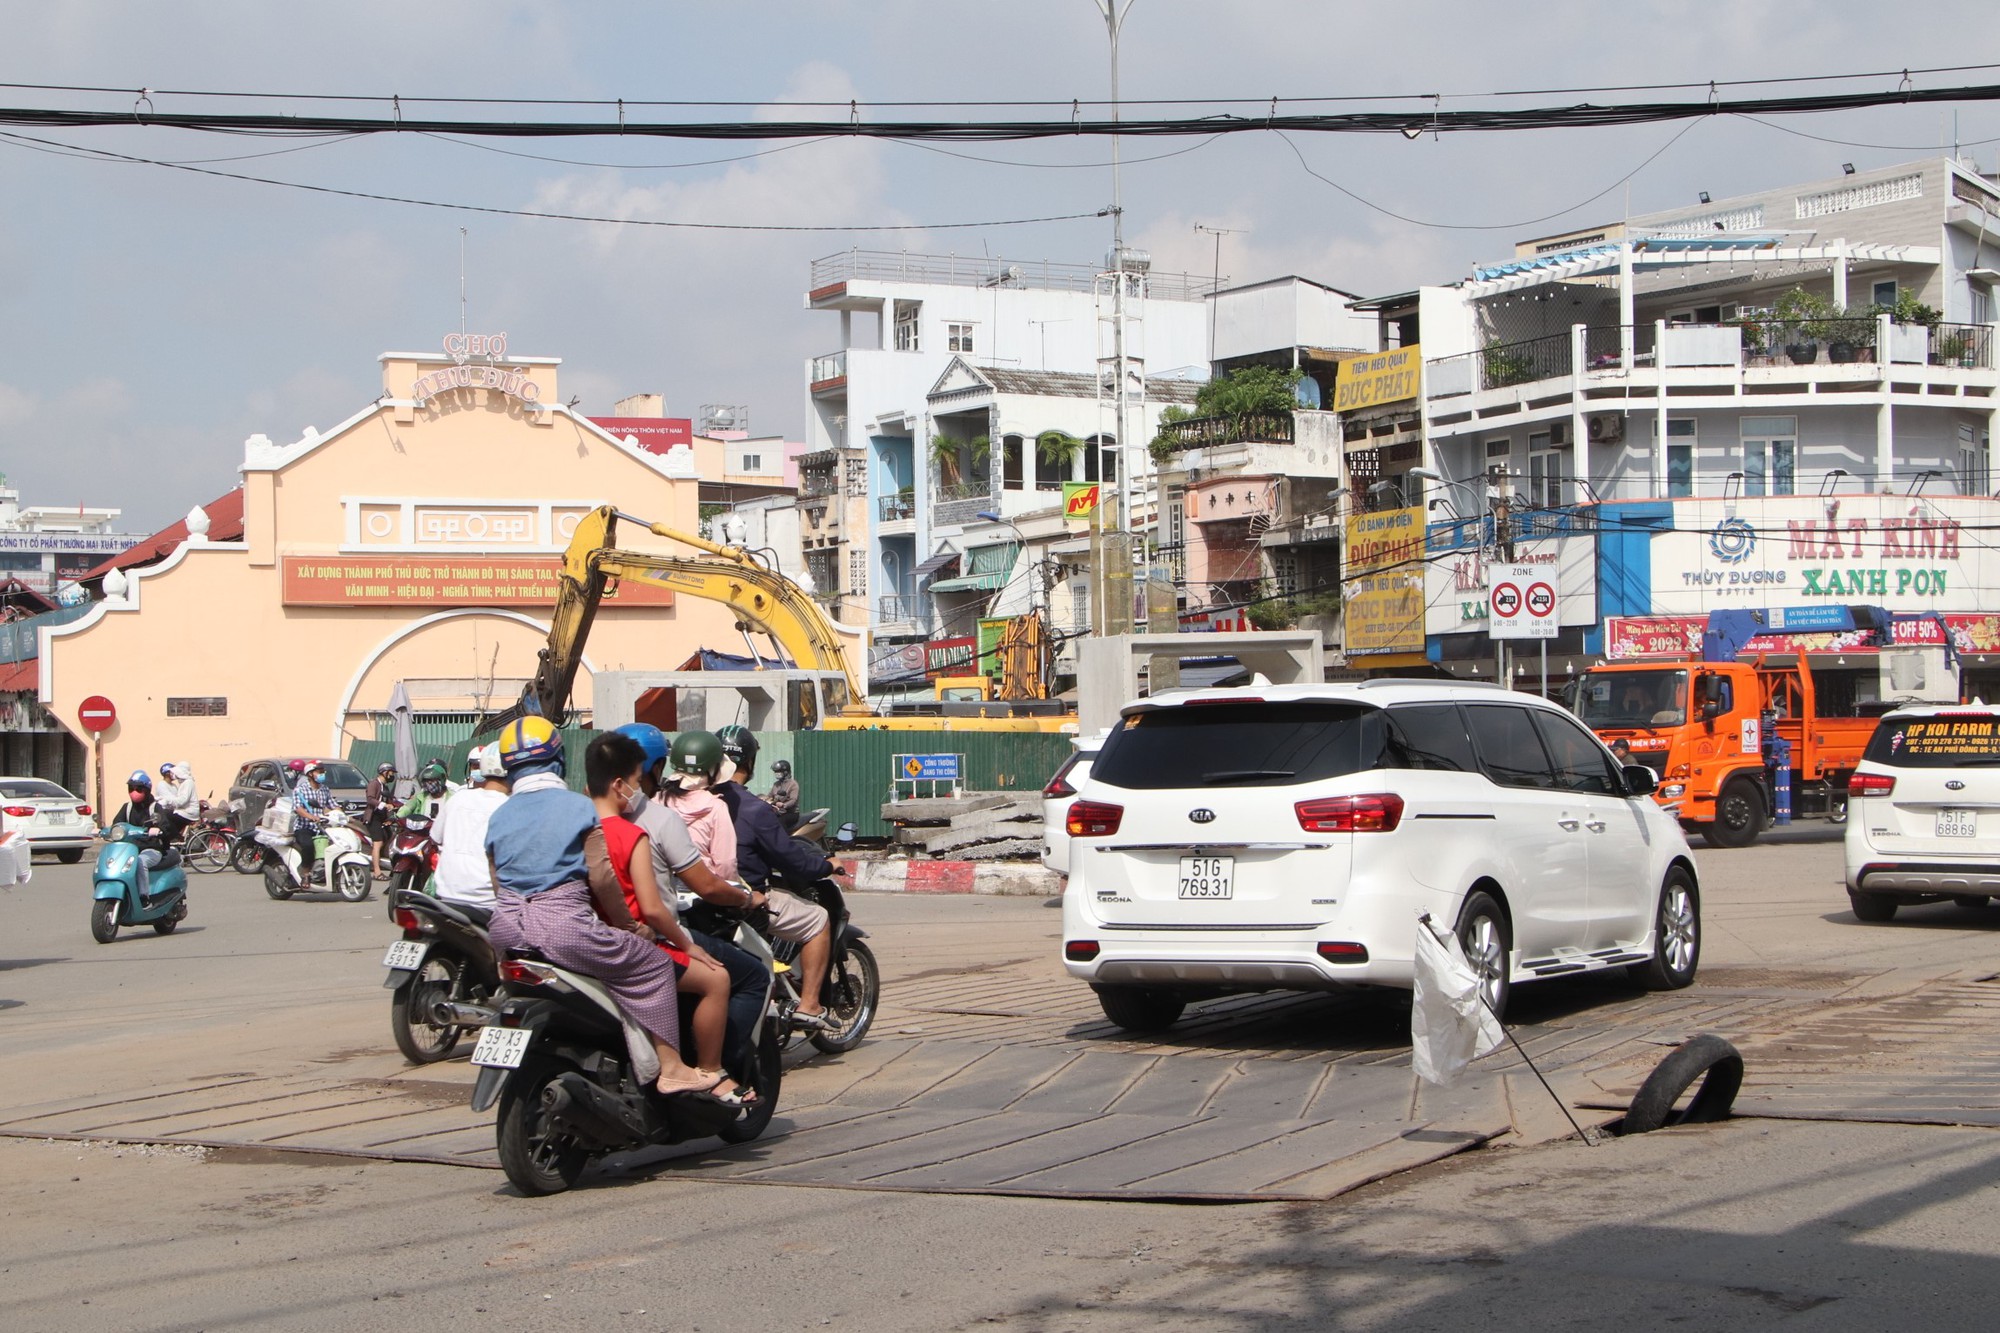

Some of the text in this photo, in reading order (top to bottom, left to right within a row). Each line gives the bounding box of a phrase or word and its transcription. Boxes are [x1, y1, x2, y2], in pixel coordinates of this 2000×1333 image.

[444, 332, 507, 361] CHỢ
[1371, 357, 1386, 371] HEO
[1387, 351, 1408, 370] QUAY
[413, 355, 540, 402] THỦ ĐỨC
[621, 426, 638, 434] NÔNG
[639, 426, 655, 434] THÔN
[656, 427, 669, 435] VIỆT
[1786, 500, 1961, 559] MẮT KÍNH
[0, 535, 17, 548] CÔNG
[19, 538, 28, 548] TY
[30, 534, 39, 548] CỔ
[100, 537, 118, 549] XUẤT
[1351, 533, 1420, 566] ĐỨC PHÁT
[298, 565, 316, 578] XÂY
[317, 566, 342, 580] DỰNG
[344, 565, 373, 579] THÀNH
[375, 564, 393, 579] PHỐ
[395, 564, 412, 579] THỦ
[413, 566, 432, 579] ĐỨC
[434, 565, 450, 579] TRỞ
[452, 565, 480, 580] THÀNH
[481, 566, 494, 580] ĐÔ
[495, 567, 509, 582] THỊ
[511, 567, 534, 580] SÁNG
[535, 568, 554, 582] TẠO,
[672, 572, 705, 585] SUMITOMO
[1512, 568, 1533, 576] ZONE
[345, 583, 364, 597] VĂN
[365, 585, 389, 597] MINH
[397, 584, 418, 599] HIỆN
[419, 585, 435, 599] ĐẠI
[442, 584, 469, 597] NGHĨA
[494, 584, 516, 597] PHÁT
[518, 582, 543, 597] TRIỂN
[1801, 568, 1948, 596] XANH PON
[1898, 621, 1917, 638] OFF
[1918, 621, 1938, 638] 50%
[1649, 636, 1682, 651] 2022
[1906, 724, 1925, 737] HP
[1925, 723, 1950, 737] KOI
[1951, 722, 1993, 736] FARM
[924, 757, 956, 767] CÔNG TRƯỜNG
[944, 768, 957, 776] CÔNG
[1191, 811, 1213, 821] KIA
[1945, 811, 1967, 823] 51F
[1192, 858, 1221, 877] 51G
[1180, 878, 1229, 897] 769.31
[1097, 895, 1133, 903] SEDONA
[387, 954, 417, 967] 5915
[485, 1028, 523, 1047] 59-X3
[473, 1046, 521, 1065] 024.87
